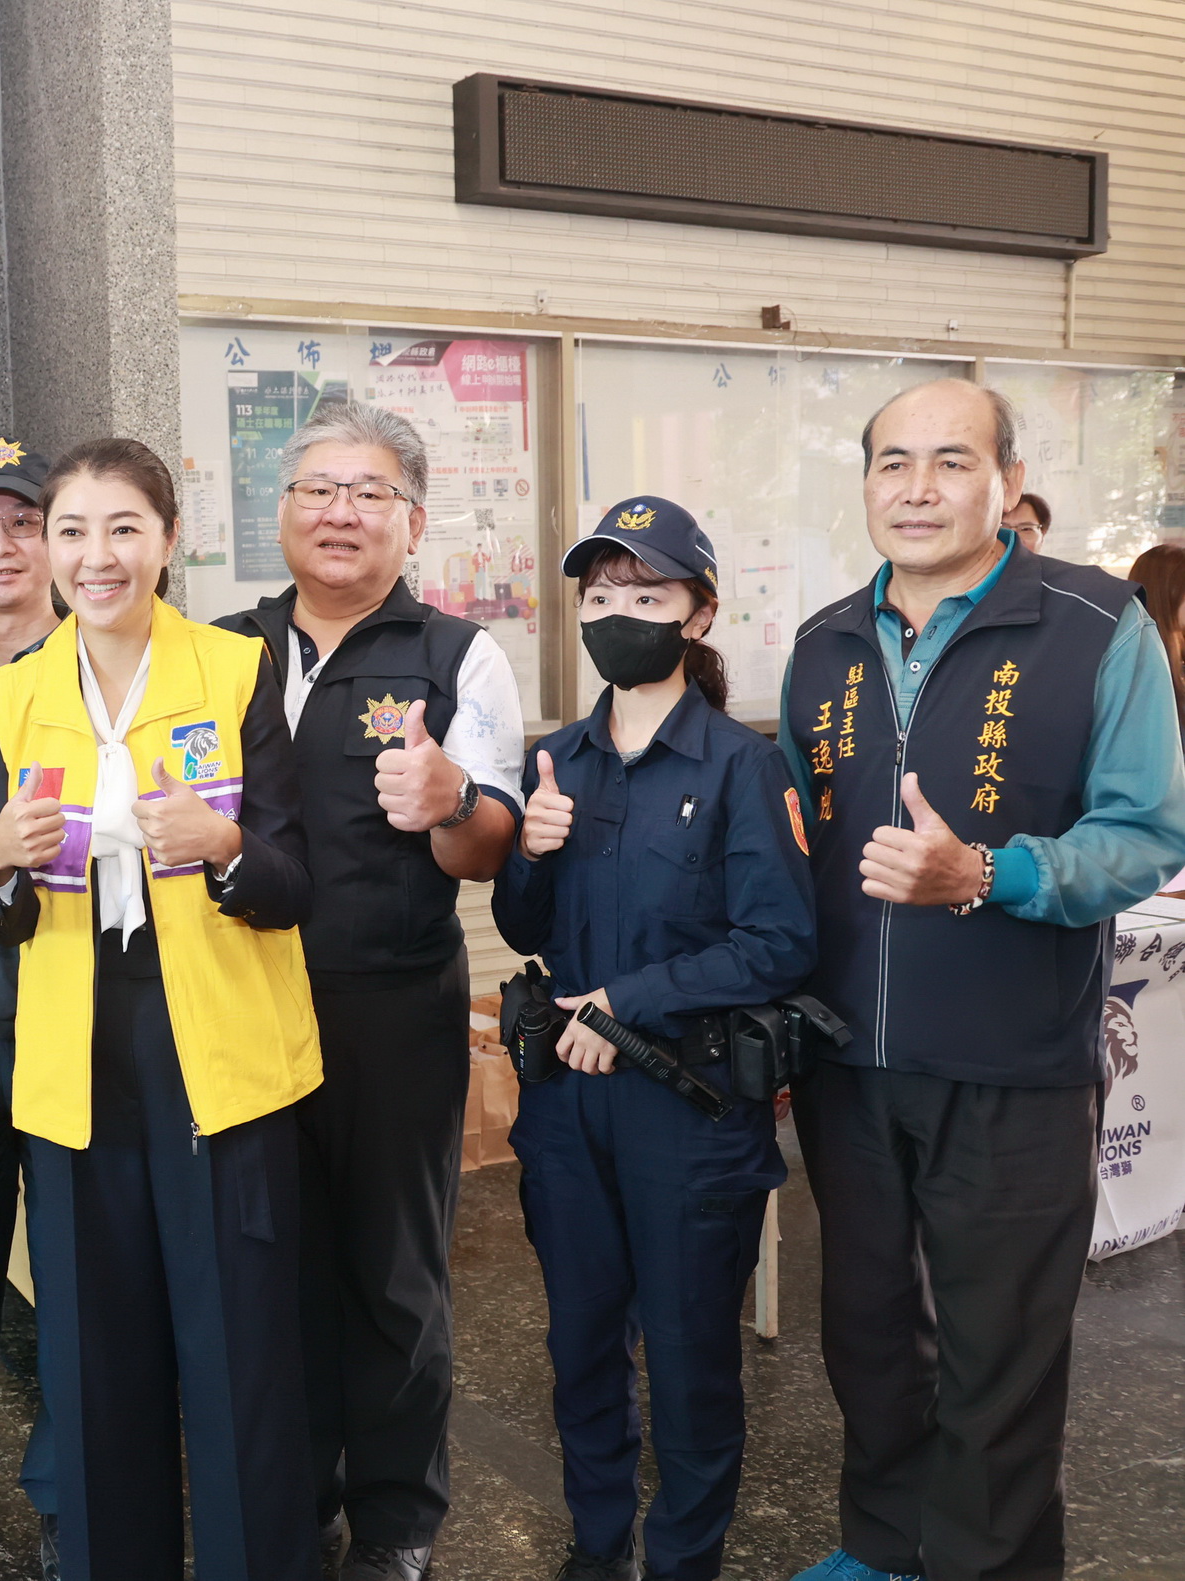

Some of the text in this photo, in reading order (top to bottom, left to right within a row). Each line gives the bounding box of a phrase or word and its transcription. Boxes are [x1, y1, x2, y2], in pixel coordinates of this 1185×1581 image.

[236, 404, 253, 416] 113
[837, 663, 864, 759] 駐區主任
[970, 660, 1020, 814] 南投縣政府
[1101, 1120, 1152, 1145] IWAN
[1099, 1140, 1142, 1163] IONS
[1100, 1160, 1133, 1180] 台灣獅
